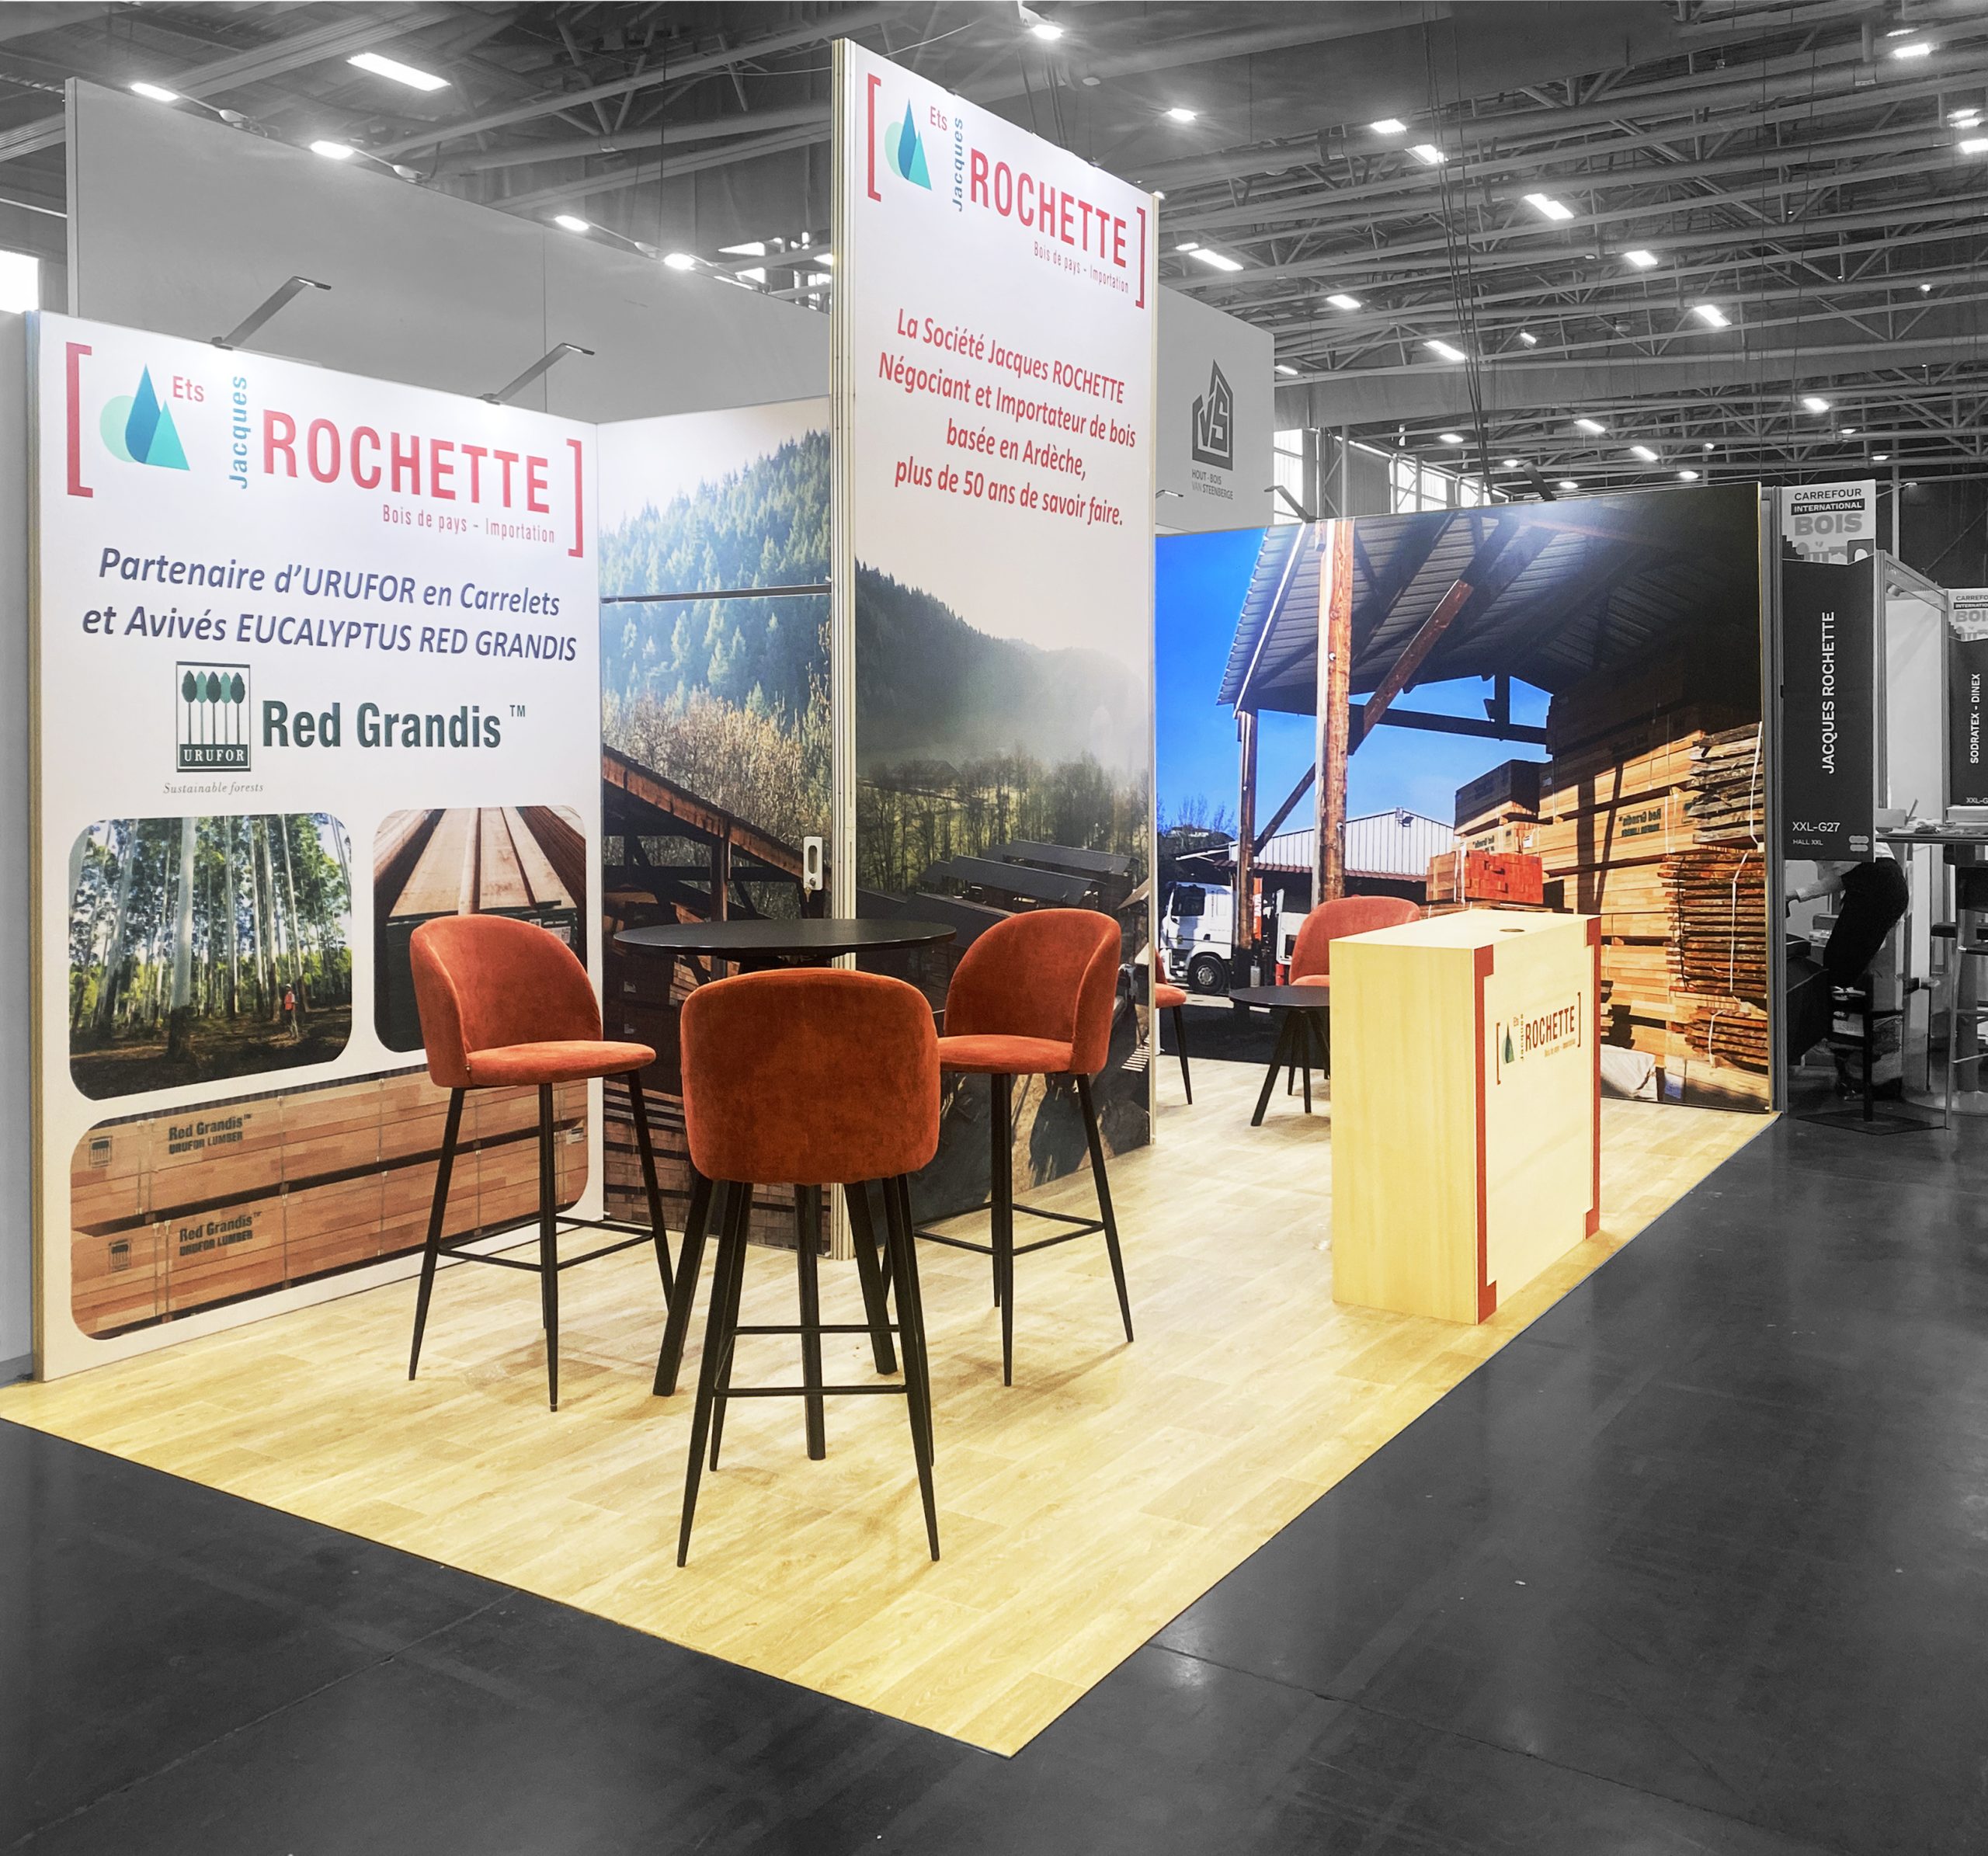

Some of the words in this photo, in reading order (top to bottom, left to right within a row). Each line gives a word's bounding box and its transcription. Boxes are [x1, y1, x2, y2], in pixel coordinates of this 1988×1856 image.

[930, 105, 947, 131] Ets
[952, 118, 964, 212] Jacques
[970, 148, 1127, 268] ROCHETTE
[1034, 241, 1050, 262] Bois
[1053, 249, 1062, 267] de
[1064, 257, 1081, 275] pays
[1090, 264, 1129, 294] Importation
[897, 308, 918, 339] La
[923, 317, 985, 360] Société
[988, 339, 1048, 381] Jacques
[1052, 360, 1125, 405] ROCHETTE
[171, 375, 205, 402] Ets
[878, 352, 971, 403] Négociant
[975, 385, 992, 408] et
[996, 387, 1086, 435] Importateur
[1090, 414, 1106, 440] de
[1109, 419, 1136, 448] bois
[228, 376, 248, 489] Jacques
[946, 418, 995, 455] basée
[999, 438, 1018, 461] en
[1022, 440, 1086, 481] Ardèche,
[262, 408, 551, 514] ROCHETTE
[1192, 469, 1206, 481] HOUT
[1209, 474, 1222, 485] BOIS
[895, 456, 933, 488] plus
[937, 464, 959, 492] de
[963, 470, 984, 497] 50
[988, 480, 1015, 505] ans
[1020, 482, 1038, 509] de
[1041, 494, 1086, 518] savoir
[1087, 495, 1123, 526] faire.
[1192, 481, 1202, 492] VAN
[1202, 483, 1233, 500] STEENBERGE
[1793, 501, 1863, 513] INTERNATIONAL
[1794, 488, 1862, 502] CARREFOUR
[382, 504, 414, 526] Bois
[416, 509, 434, 528] de
[438, 514, 467, 534] pays
[485, 517, 555, 544] Importation
[1795, 513, 1863, 536] BOIS
[98, 547, 265, 592] Partenaire
[422, 583, 453, 607] en
[460, 583, 561, 617] Carrelets
[82, 605, 116, 635] et
[124, 605, 227, 642] Avivés
[235, 613, 412, 653] EUCALYPTUS
[419, 629, 467, 655] RED
[474, 634, 578, 662] GRANDIS
[1822, 611, 1835, 697] ROCHETTE
[1971, 673, 1980, 703] DINEX
[262, 700, 342, 749] Red
[356, 702, 502, 749] Grandis
[1822, 700, 1837, 774] JACQUES
[1970, 712, 1980, 764] SODRATEX
[183, 748, 245, 763] URUFOR
[162, 780, 225, 794] Sustainable
[228, 782, 264, 796] forests
[1792, 822, 1840, 832] XXL-G27
[1525, 1006, 1575, 1052] ROCHETTE
[168, 1123, 193, 1142] Red
[196, 1116, 243, 1135] Grandis
[207, 1131, 243, 1147] LUMBER
[179, 1224, 203, 1243] Red
